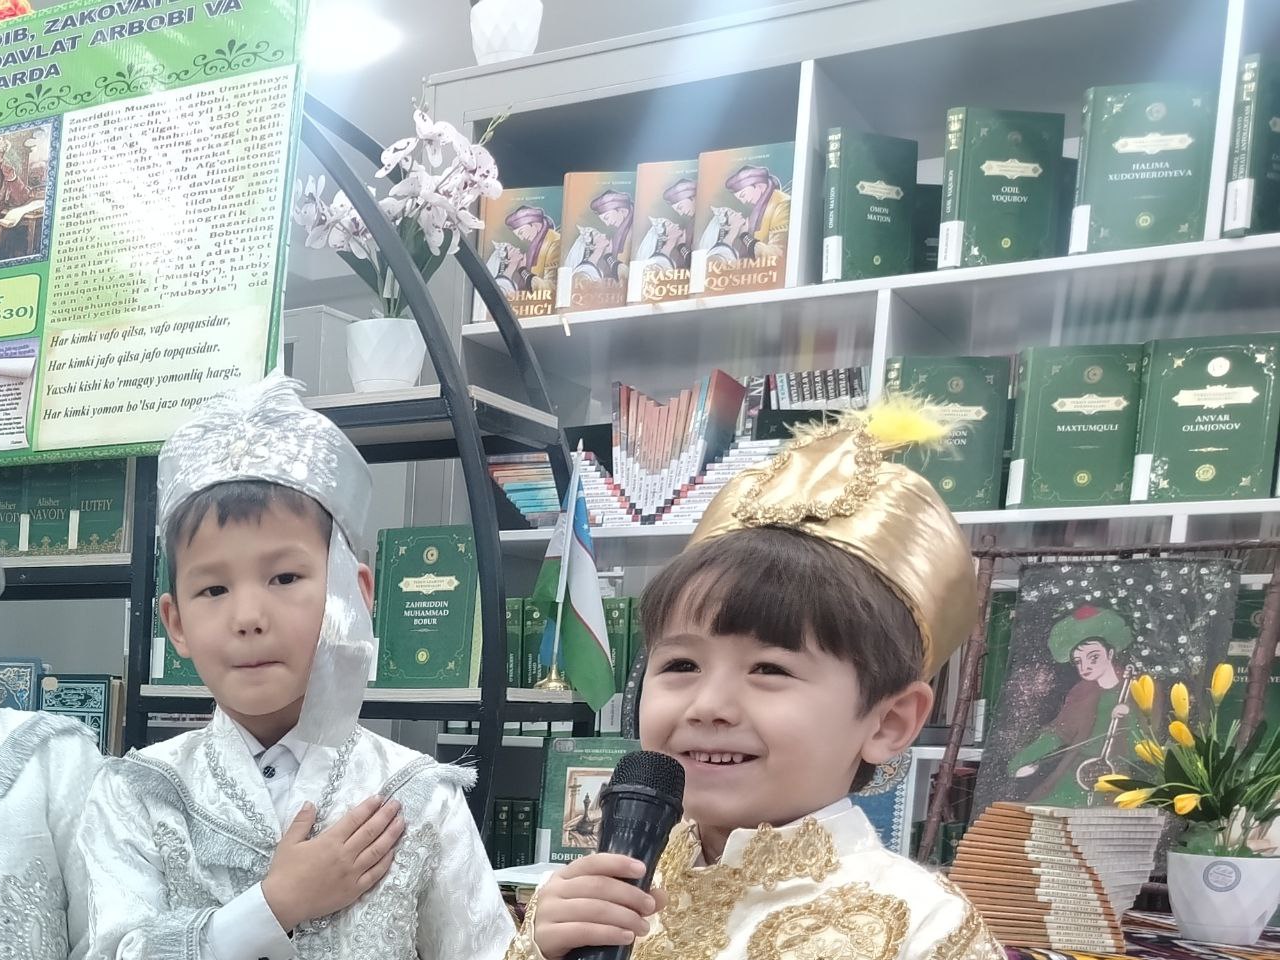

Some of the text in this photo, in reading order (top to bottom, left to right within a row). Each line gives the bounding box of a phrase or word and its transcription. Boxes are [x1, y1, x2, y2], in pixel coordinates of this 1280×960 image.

[89, 6, 195, 47] ARBOBI
[204, 0, 243, 19] VA
[1132, 161, 1170, 171] HALIMA
[1108, 169, 1193, 181] XUDOYBERDIYEVA
[1001, 186, 1020, 194] ODIL
[708, 255, 777, 274] KASHMIR
[50, 314, 231, 348] Har kimki vafo qilsa, vafo topqusidur,
[48, 342, 221, 372] Har kimki jafo qilsa jafo topqusidur.
[46, 364, 242, 396] Yaxshi kishi ko'rmagay yomonliq hargiz,
[43, 397, 178, 421] Har kimki yomon bo'lsa jazo
[1195, 414, 1230, 423] ANVAR
[1056, 423, 1119, 432] MAXTUMQULI
[1182, 422, 1241, 433] OLIMJONOV
[37, 497, 60, 507] Alisher
[80, 499, 113, 512] LUTFIY
[29, 509, 67, 520] NAVOIY
[405, 600, 449, 608] ZAHIRIDDIN
[403, 609, 450, 617] MUHAMMAD
